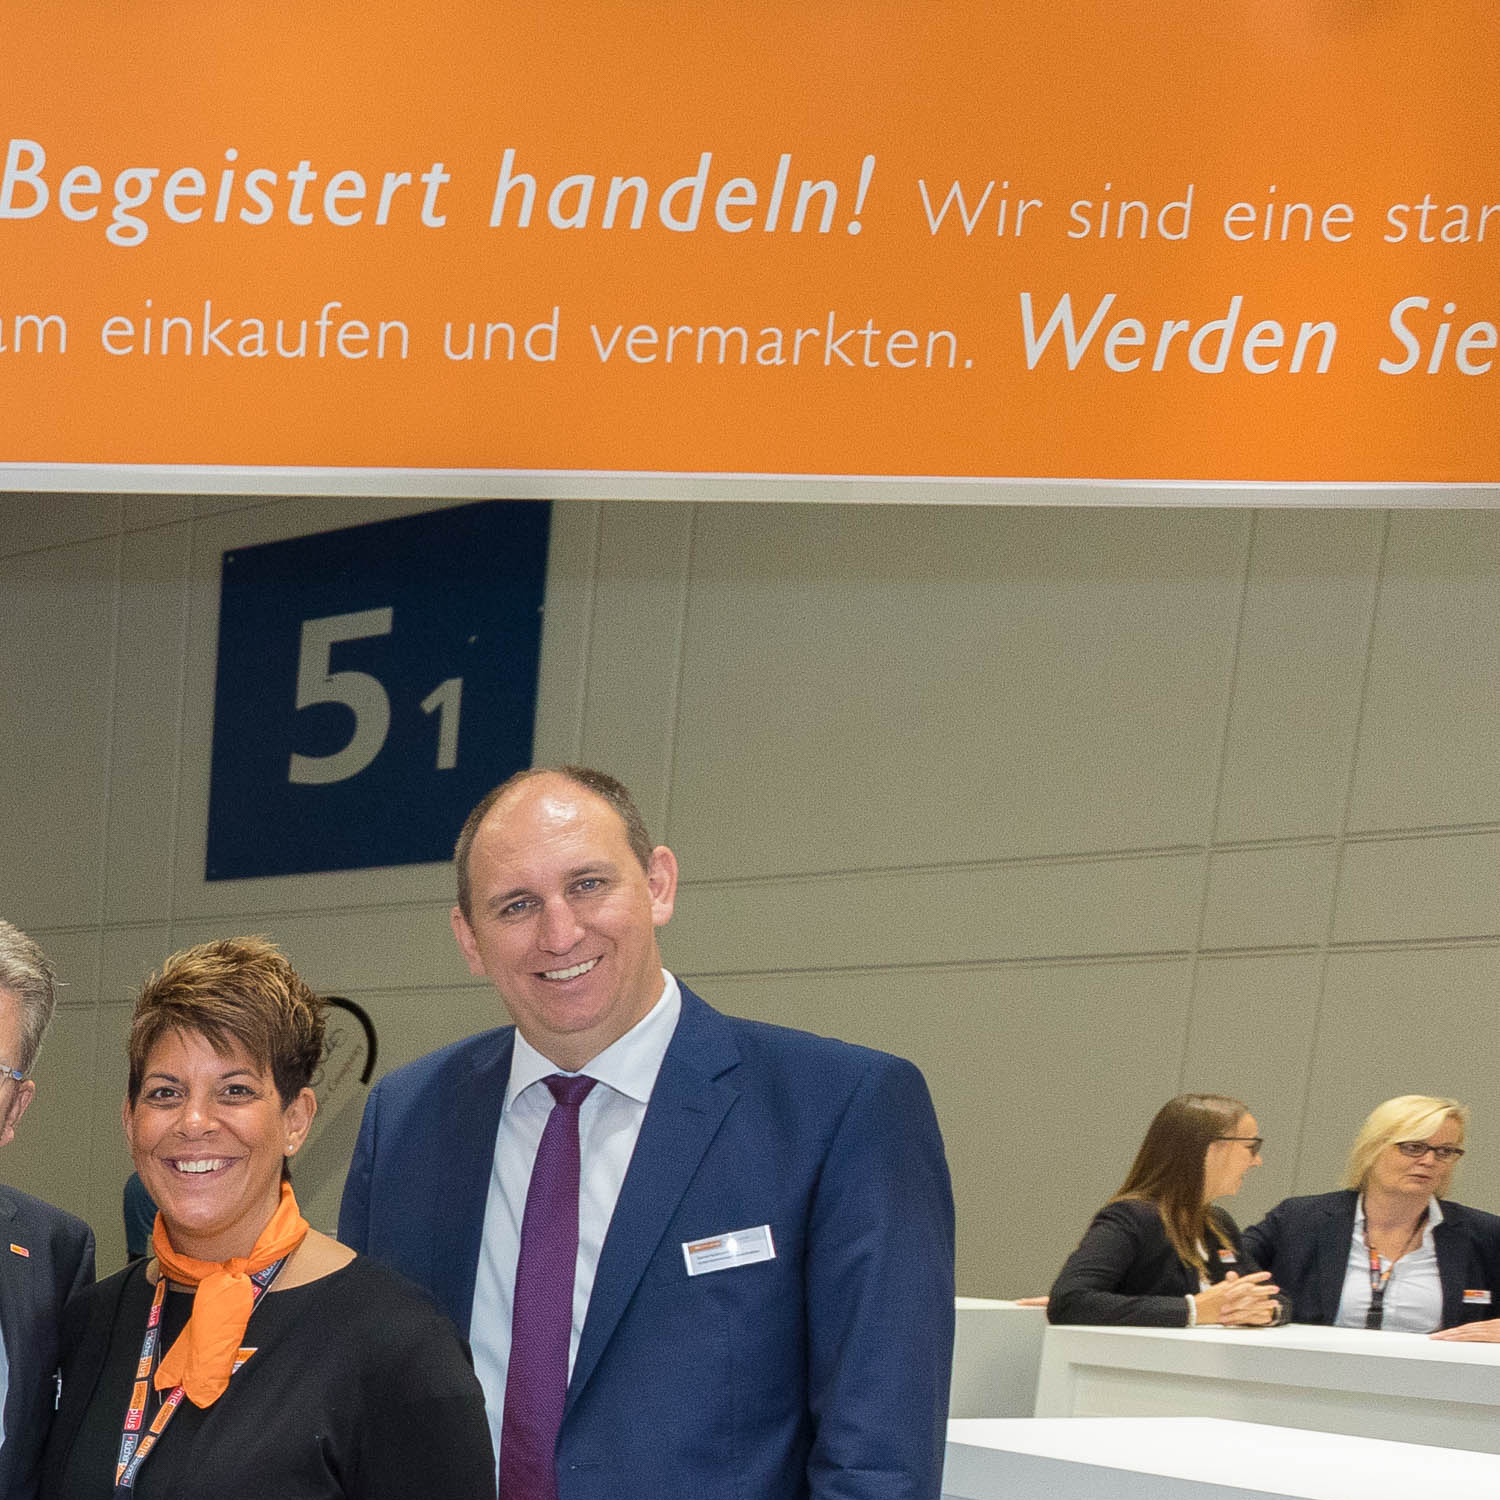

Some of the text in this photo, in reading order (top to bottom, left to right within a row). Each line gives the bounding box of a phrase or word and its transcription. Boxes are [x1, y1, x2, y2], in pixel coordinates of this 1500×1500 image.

[489, 147, 876, 238] handeln!
[918, 178, 1042, 238] Wir
[1067, 183, 1195, 241] sind
[1222, 184, 1356, 243] eine
[101, 298, 409, 361] einkaufen
[443, 306, 560, 363] und
[590, 310, 973, 371] vermarkten.
[1019, 292, 1337, 376] Werden
[1379, 296, 1500, 376] Sie
[287, 606, 394, 785] 5
